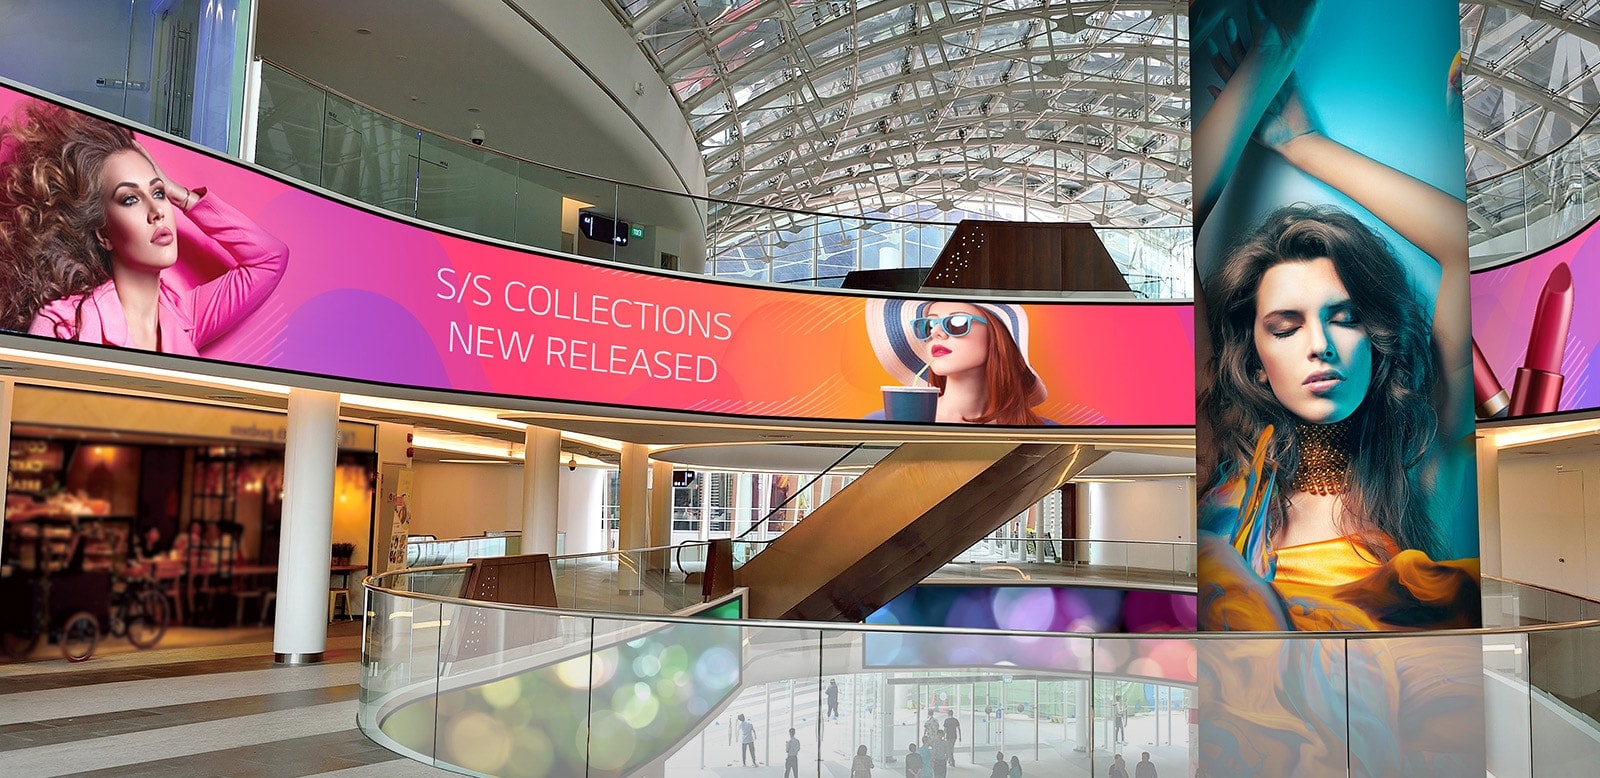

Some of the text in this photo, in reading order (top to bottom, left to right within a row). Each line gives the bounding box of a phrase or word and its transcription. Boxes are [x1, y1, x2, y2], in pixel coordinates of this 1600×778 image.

[436, 267, 733, 341] S/S COLLECTIONS
[449, 320, 718, 383] NEW RELEASED
